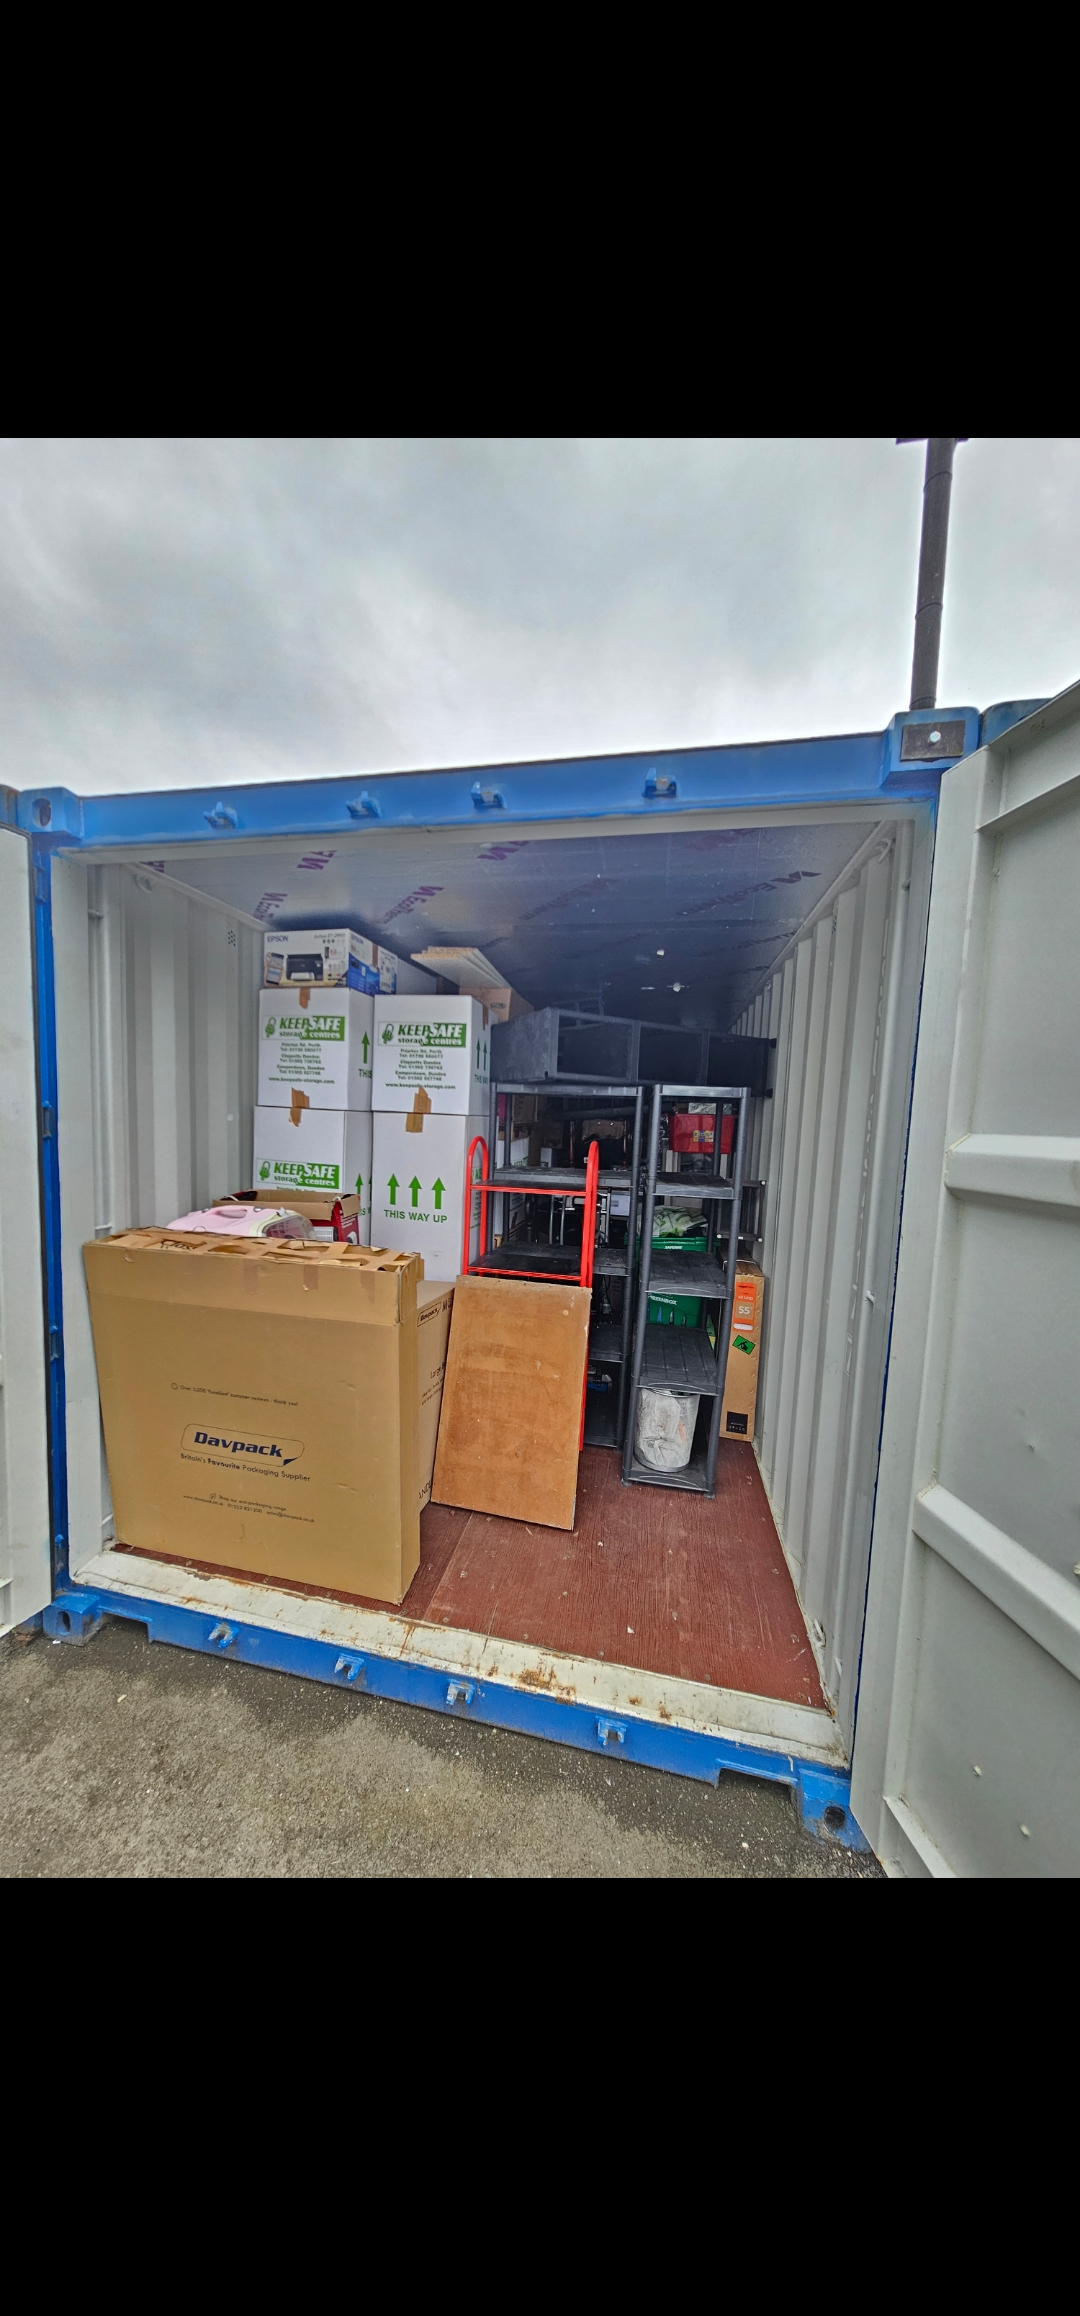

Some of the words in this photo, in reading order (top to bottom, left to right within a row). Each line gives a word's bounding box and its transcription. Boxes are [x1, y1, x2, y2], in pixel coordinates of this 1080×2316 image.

[279, 1017, 341, 1031] KEEPSAFE
[398, 1024, 463, 1037] KEEPSAFE
[279, 1032, 307, 1040] storage
[398, 1037, 428, 1046] storage
[274, 1162, 335, 1178] KEEPSAFE
[274, 1175, 303, 1184] storage
[384, 1209, 405, 1219] THIS
[408, 1212, 430, 1221] WAY
[433, 1215, 447, 1223] UP
[194, 1432, 282, 1457] Davpack
[180, 1453, 206, 1464] Britain's
[208, 1458, 240, 1470] Favourite
[242, 1465, 279, 1478] Packaging
[281, 1471, 310, 1481] Supplier
